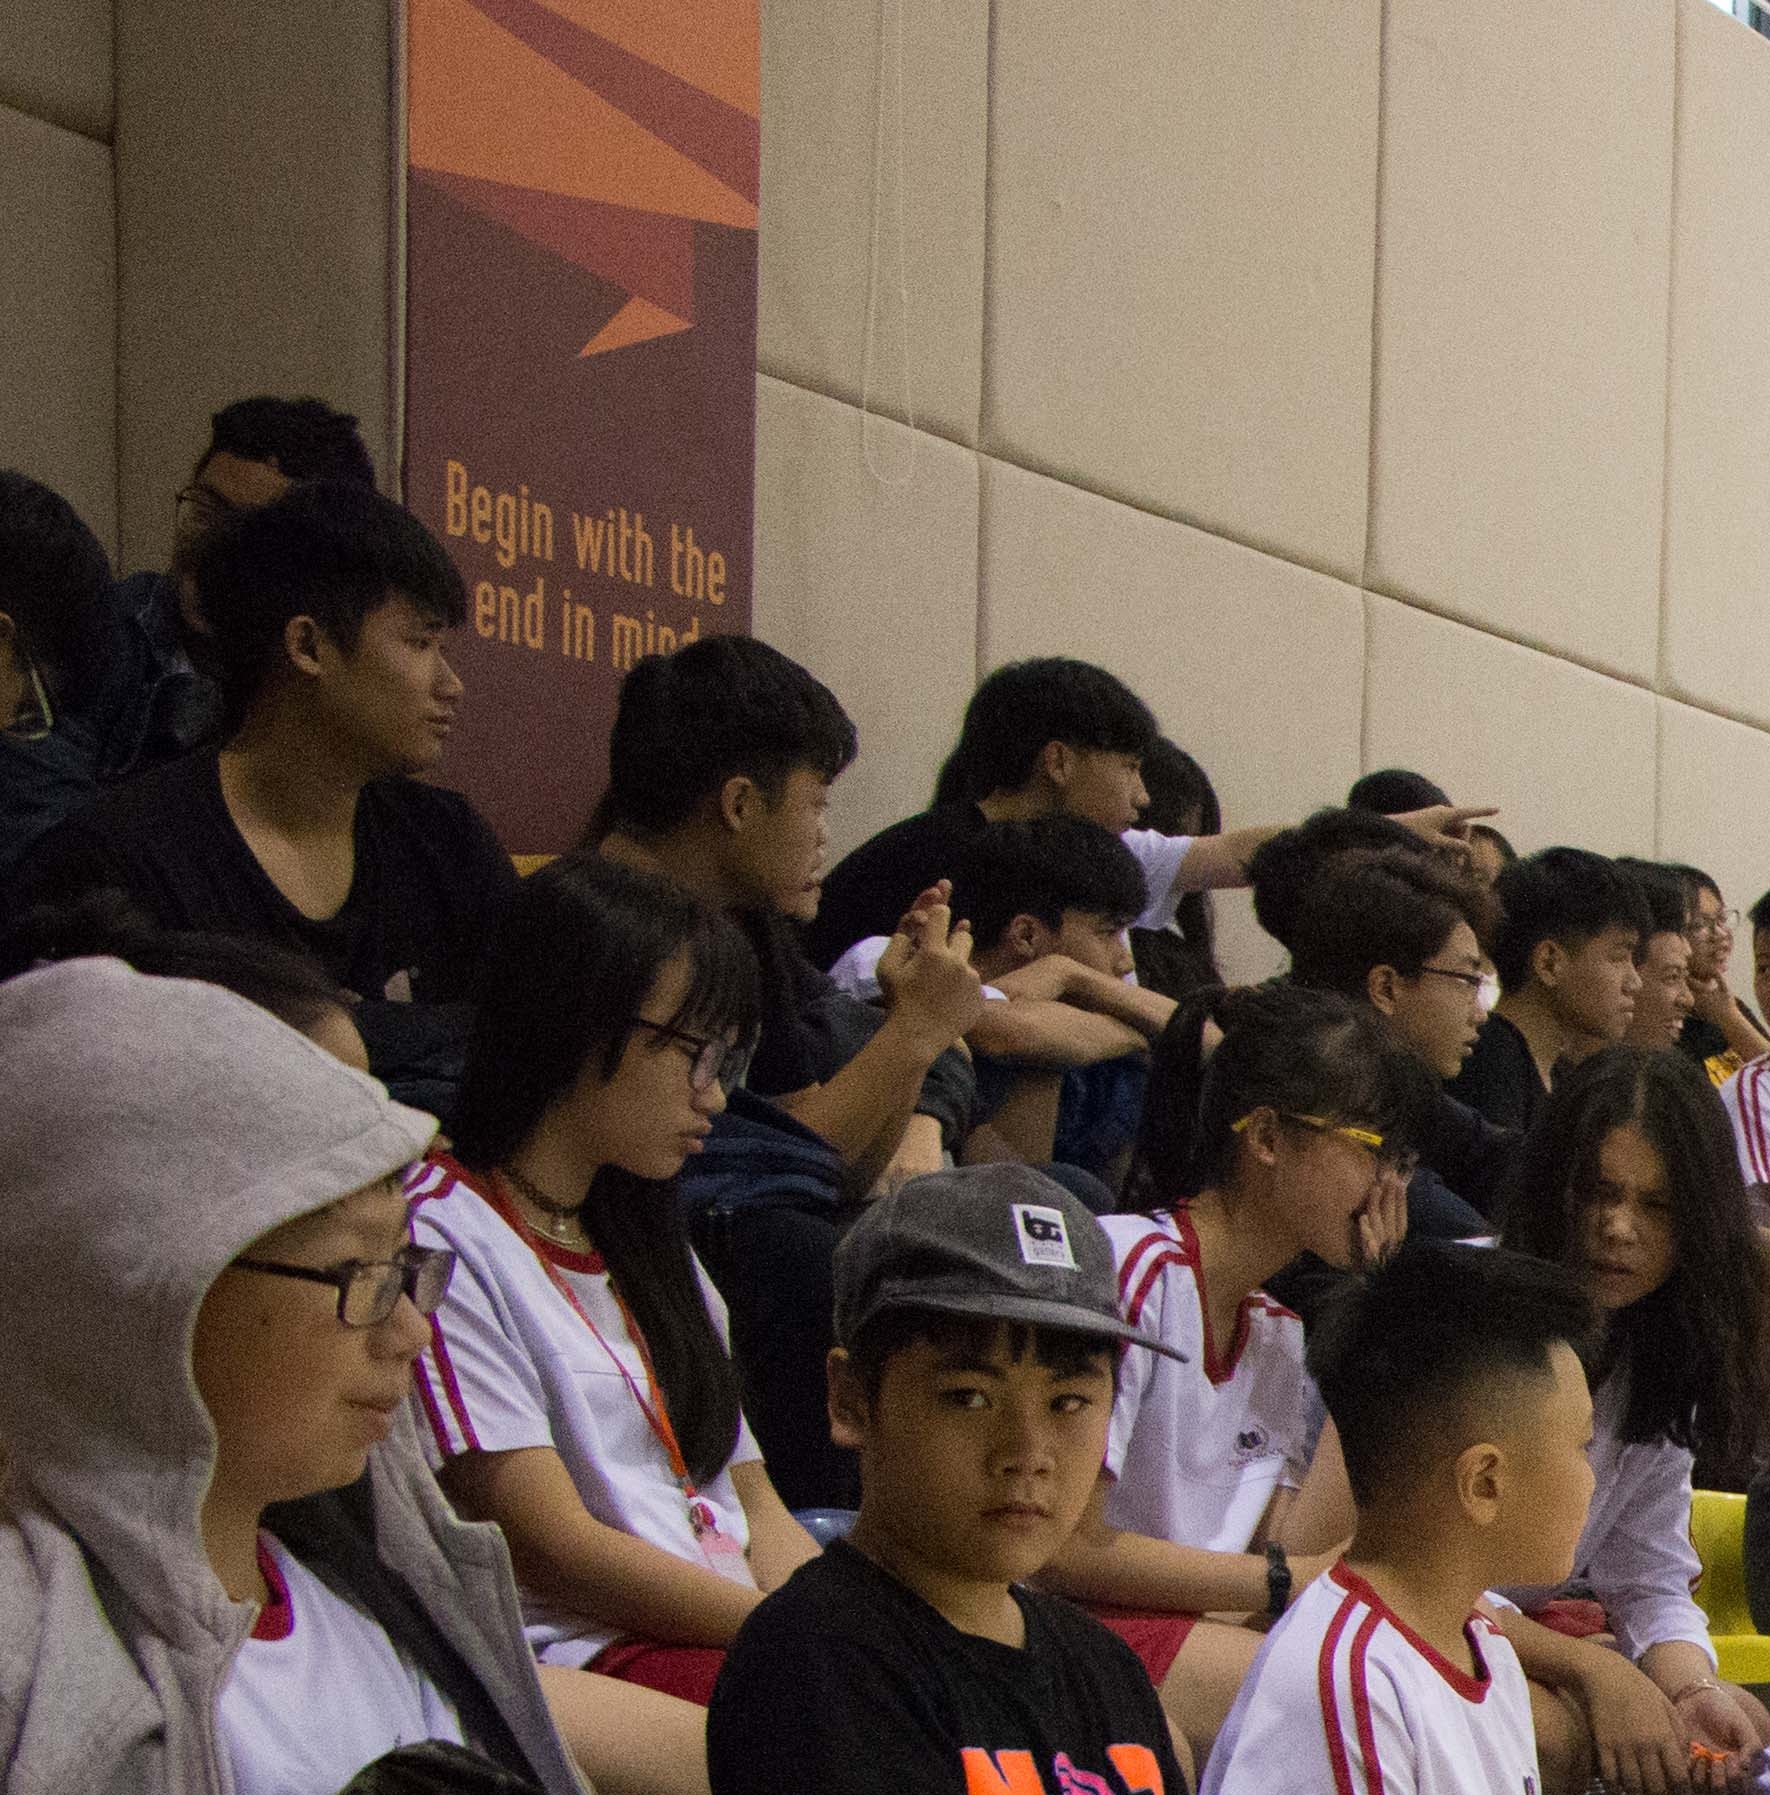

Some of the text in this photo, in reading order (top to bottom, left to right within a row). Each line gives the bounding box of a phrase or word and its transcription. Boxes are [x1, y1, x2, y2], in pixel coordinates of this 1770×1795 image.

[447, 459, 727, 605] Begin with the
[474, 576, 543, 650] end
[562, 588, 594, 662] in
